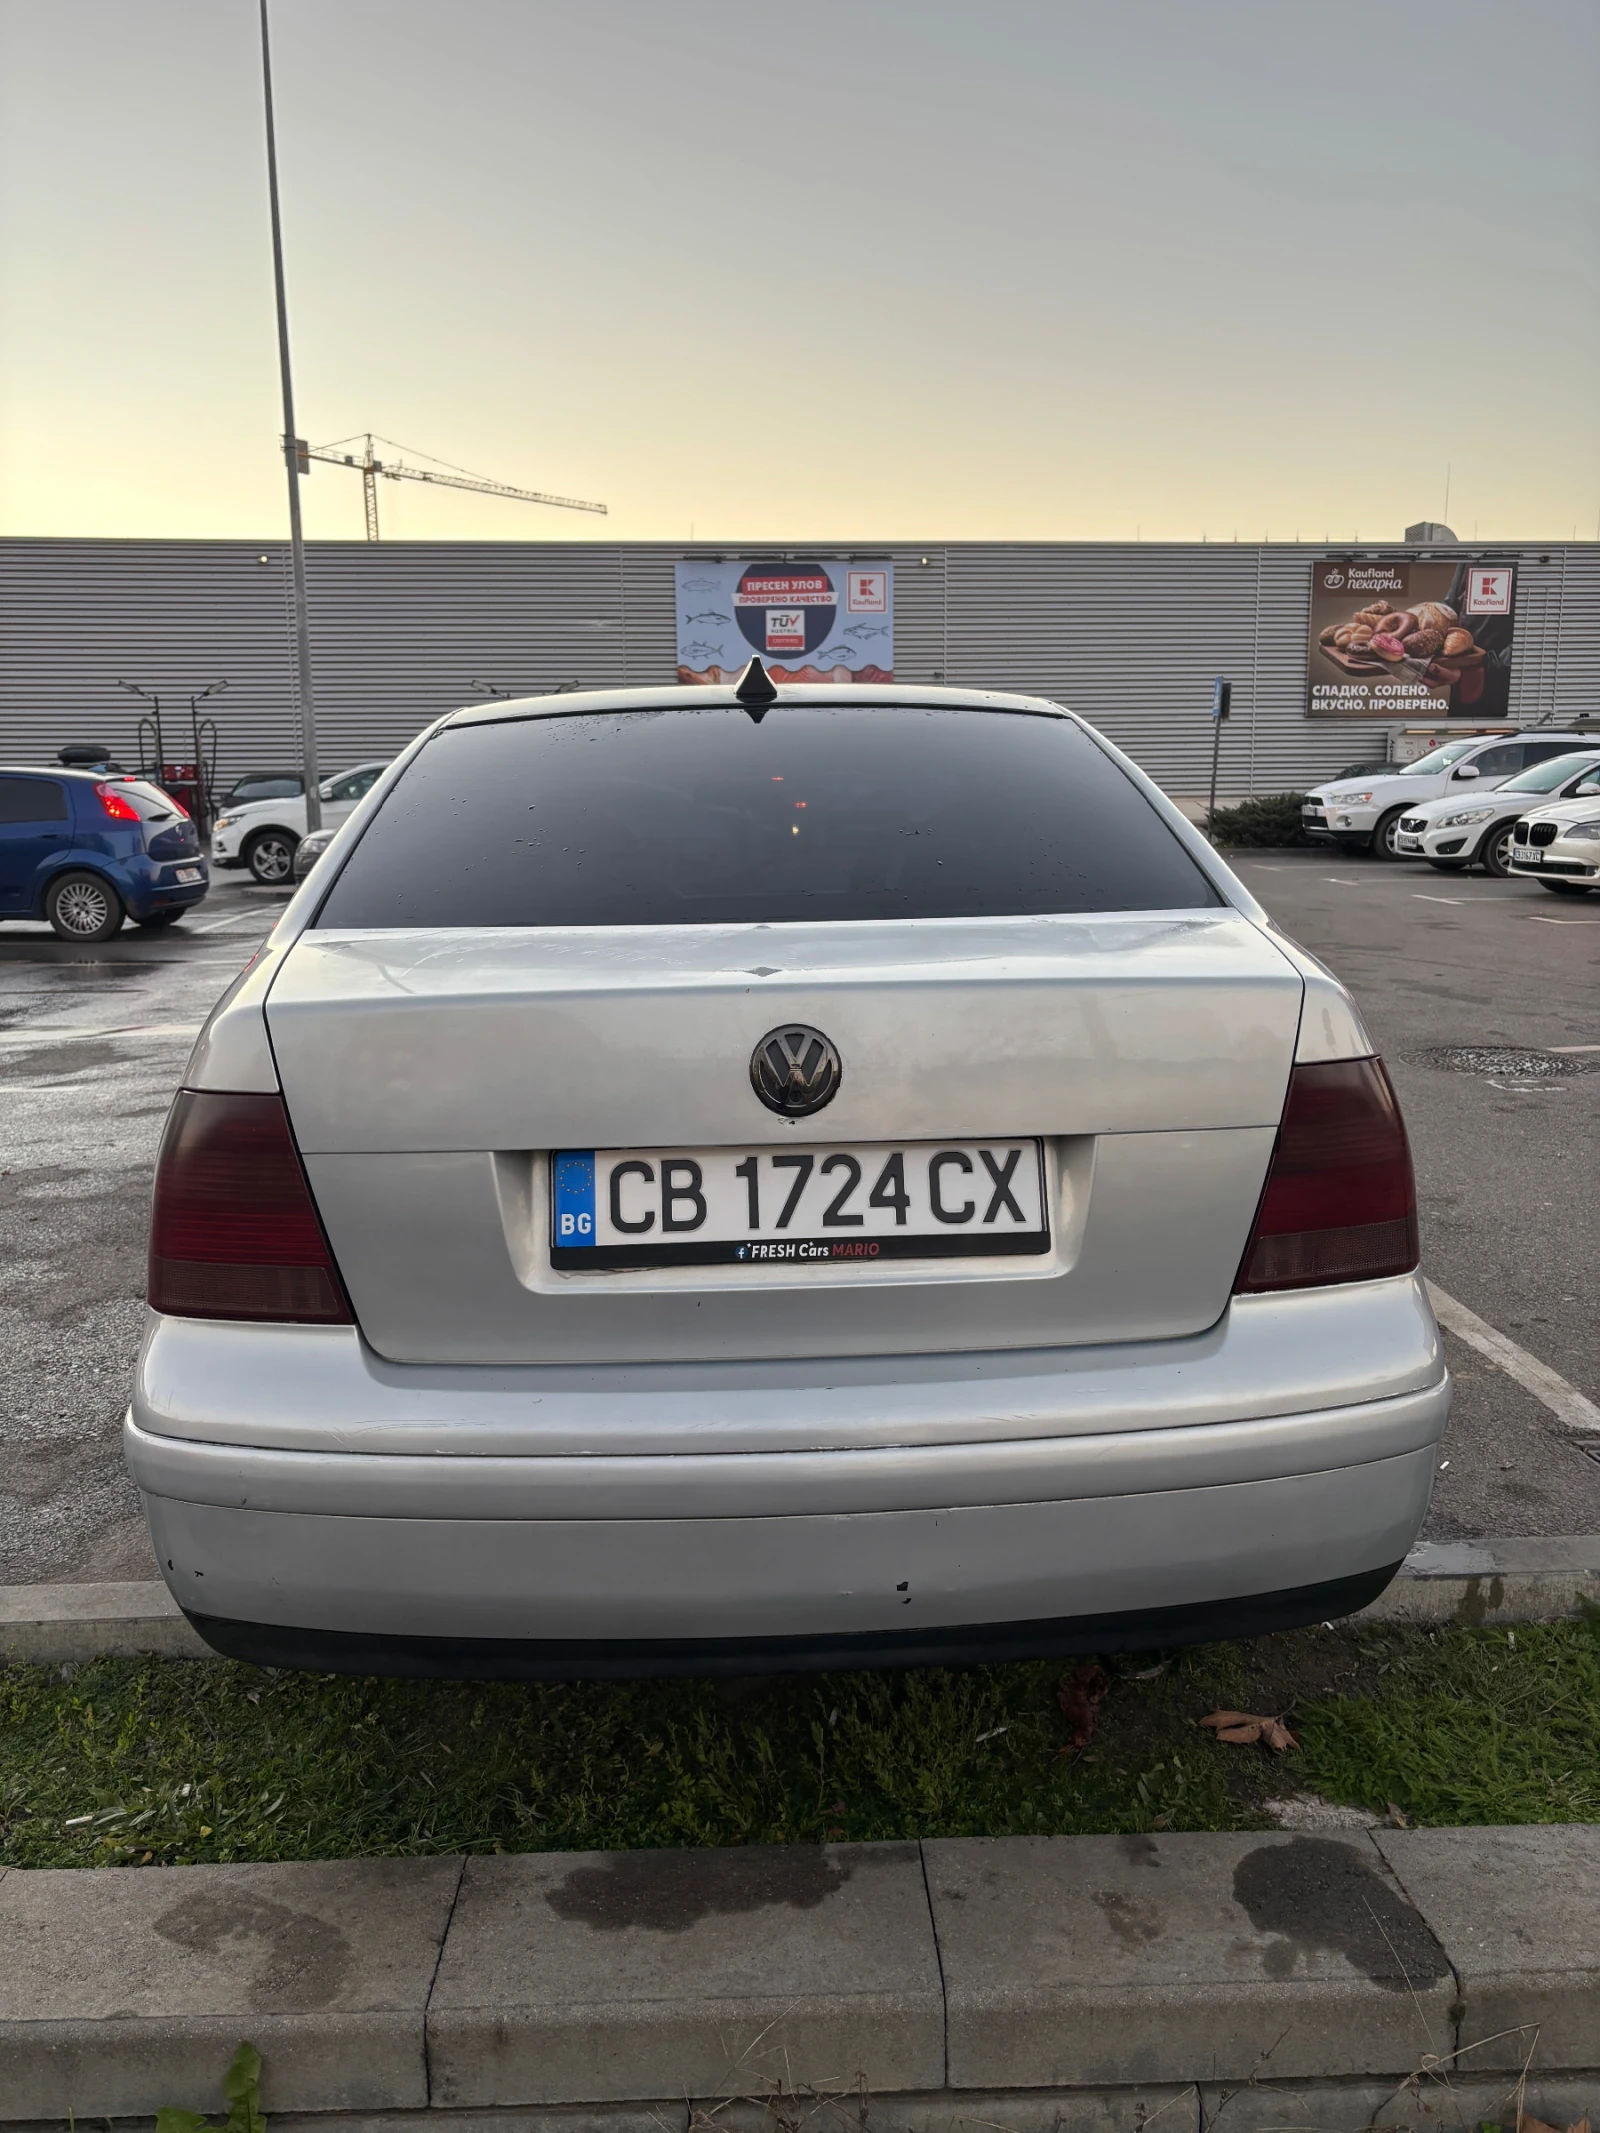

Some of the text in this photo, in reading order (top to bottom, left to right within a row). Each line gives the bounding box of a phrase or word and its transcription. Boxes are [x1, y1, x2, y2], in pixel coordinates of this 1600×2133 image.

[1348, 568, 1394, 578] Kaufland
[746, 580, 823, 591] ПРЕСЕН УЛОВ
[1347, 579, 1403, 592] пекарна
[739, 595, 833, 604] ПРОВЕРЕНО КАЧЕСТВО
[1473, 598, 1504, 606] Kaufland
[1312, 685, 1430, 697] СЛАДКО. СОЛЕНО.
[1311, 699, 1449, 710] ВКУСНО. ПРОВЕРЕНО.
[609, 1150, 1026, 1234] CB 1724 CX
[561, 1213, 592, 1235] BG
[751, 1244, 796, 1258] FRESH
[799, 1243, 829, 1257] Cars
[832, 1243, 880, 1256] MARIO
